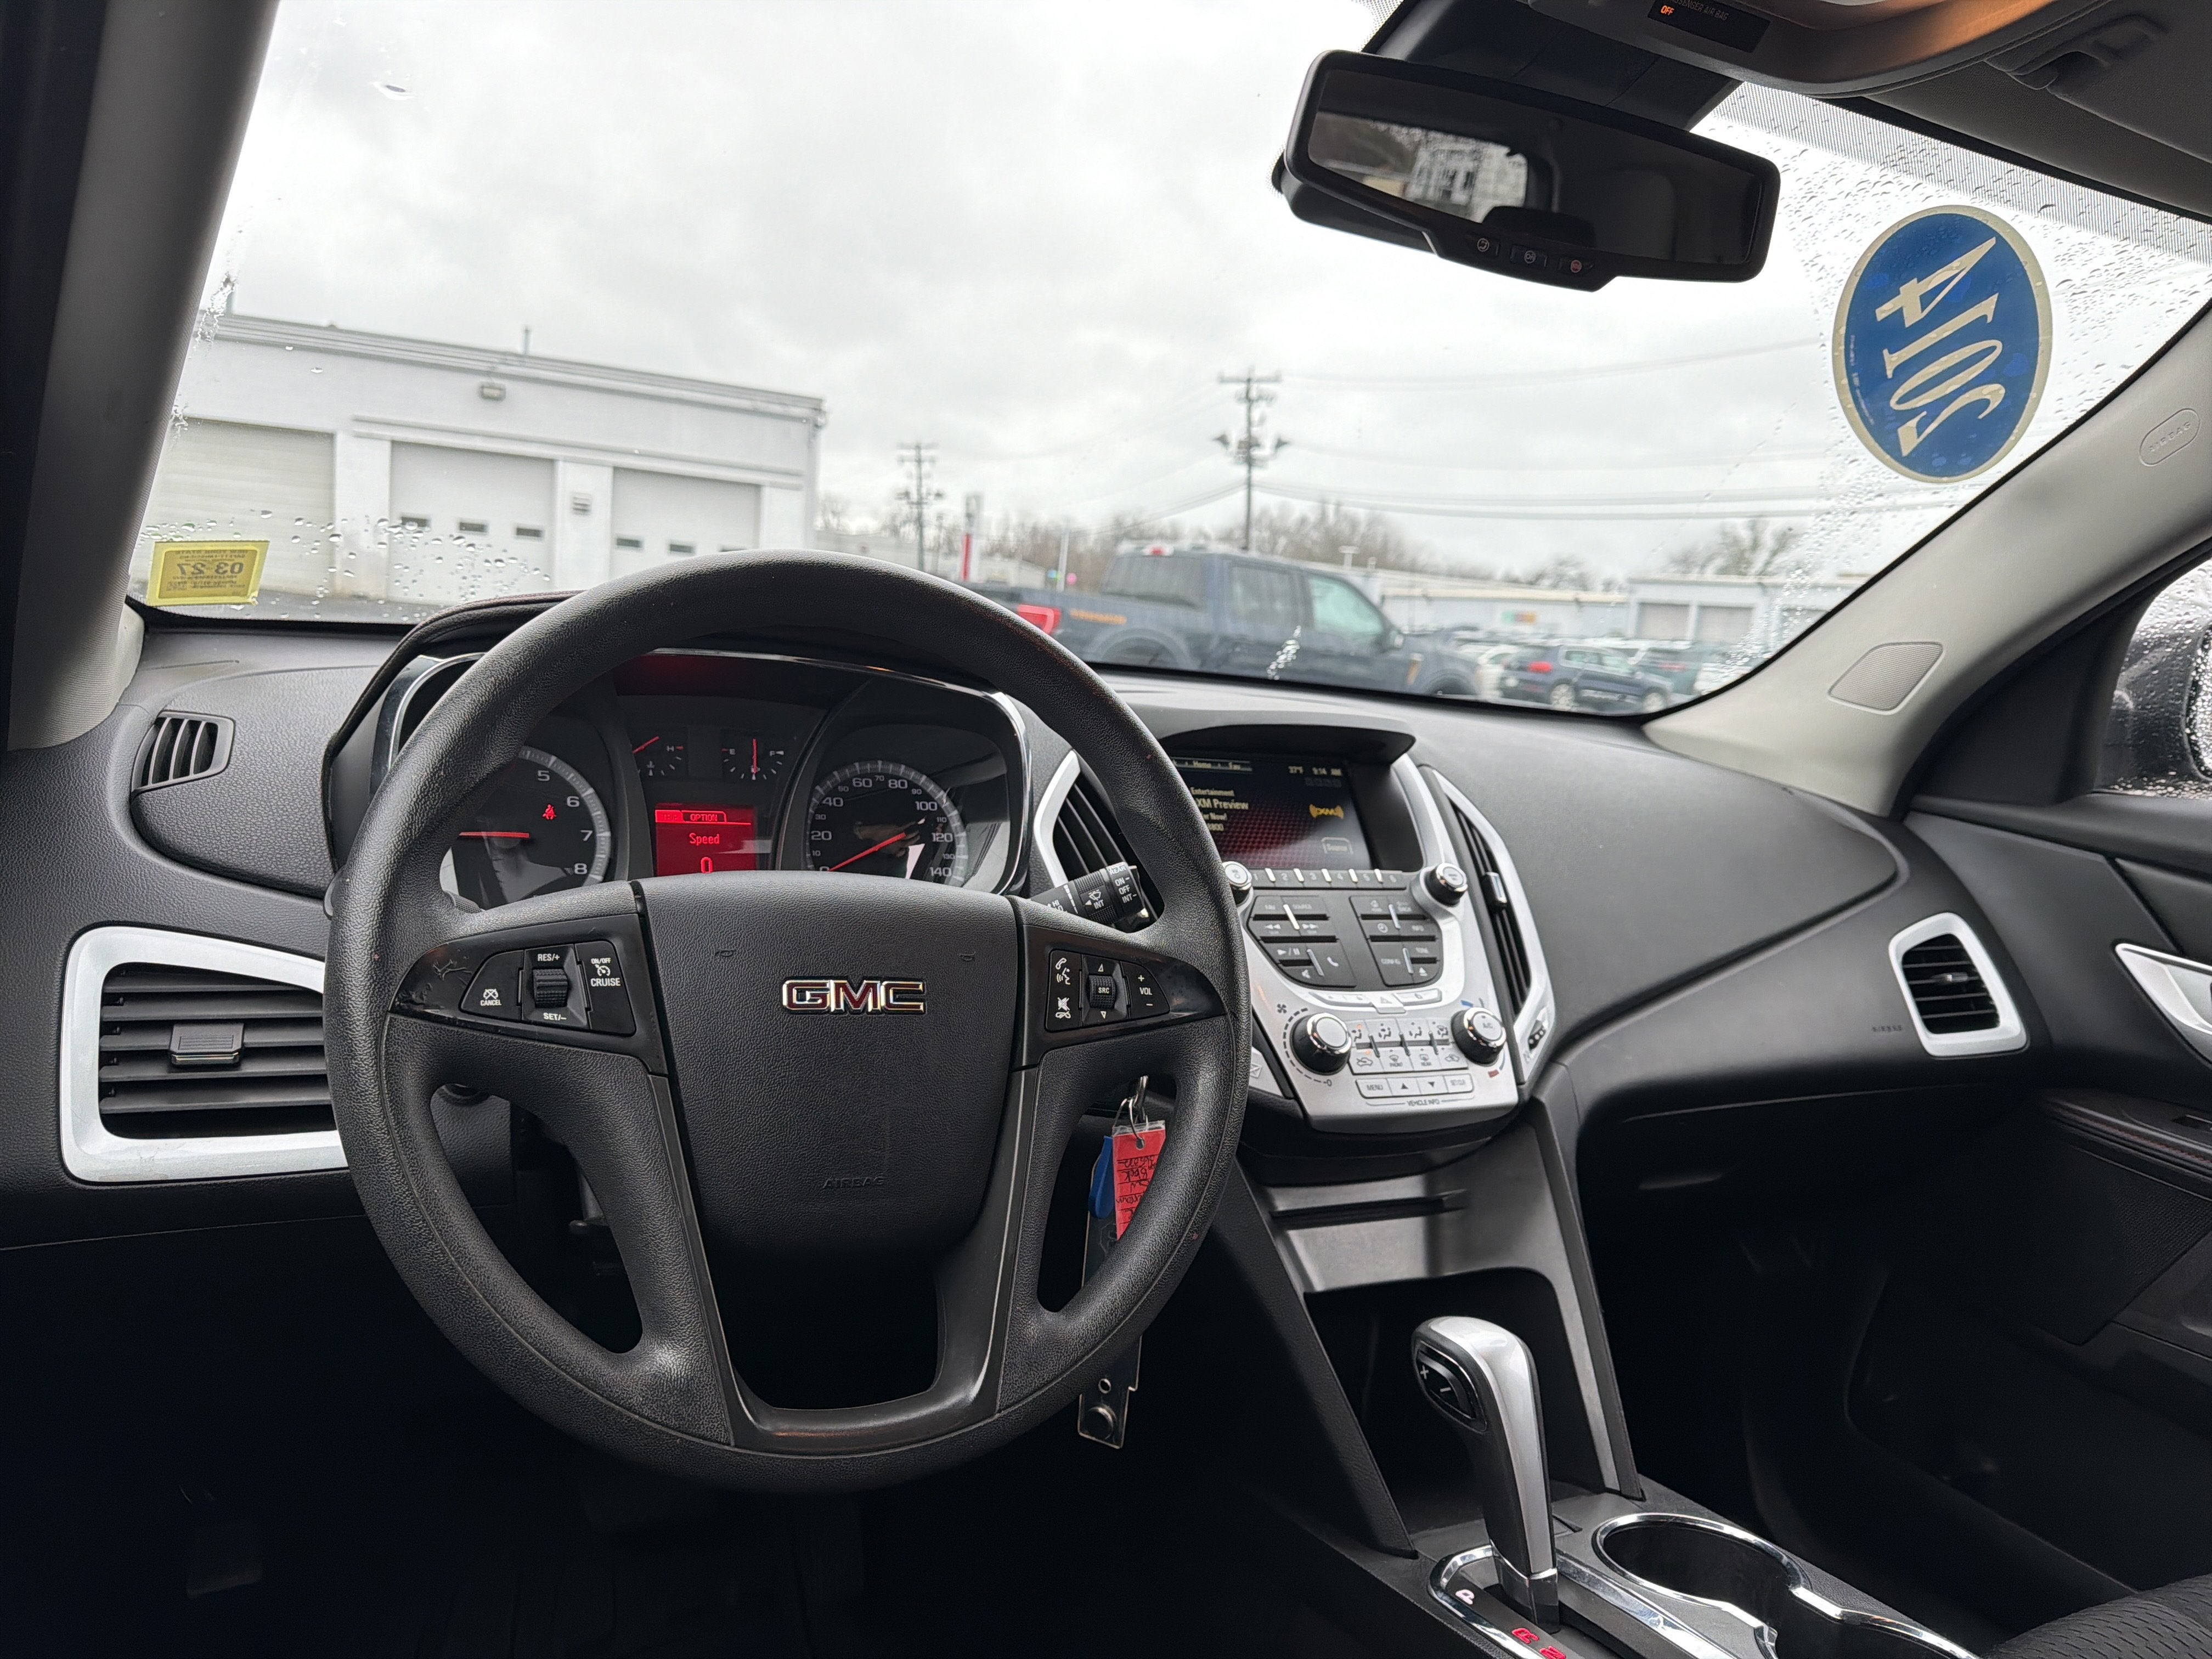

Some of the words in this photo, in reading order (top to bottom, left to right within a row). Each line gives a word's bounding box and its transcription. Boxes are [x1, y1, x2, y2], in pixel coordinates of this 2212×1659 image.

[1661, 5, 1674, 15] OFF
[2148, 421, 2191, 453] AIRBAG
[537, 770, 550, 782] 5
[852, 778, 873, 788] 60
[888, 779, 908, 789] 80
[566, 796, 580, 808] 6
[823, 797, 844, 808] 40
[915, 802, 938, 811] 100
[1212, 798, 1249, 810] Preview
[690, 814, 718, 822] OPTION
[580, 830, 593, 841] 7
[689, 832, 720, 846] Speed
[811, 831, 832, 841] 20
[932, 833, 953, 843] 120
[574, 863, 588, 875] 8
[701, 856, 713, 873] 0
[930, 867, 952, 877] 140
[1109, 866, 1126, 876] REAR
[1115, 877, 1125, 886] ON
[1281, 873, 1288, 881] 2
[1119, 886, 1130, 895] OFF
[1052, 899, 1060, 907] HI
[1122, 895, 1133, 904] INT
[1093, 900, 1104, 910] INT
[538, 953, 560, 962] RES/+
[590, 978, 621, 987] CRUISE
[782, 979, 924, 1013] GMC
[1139, 987, 1153, 995] VOL
[822, 1176, 885, 1189] AIRBAG
[1455, 1588, 1475, 1605] P
[1511, 1628, 1540, 1645] R
